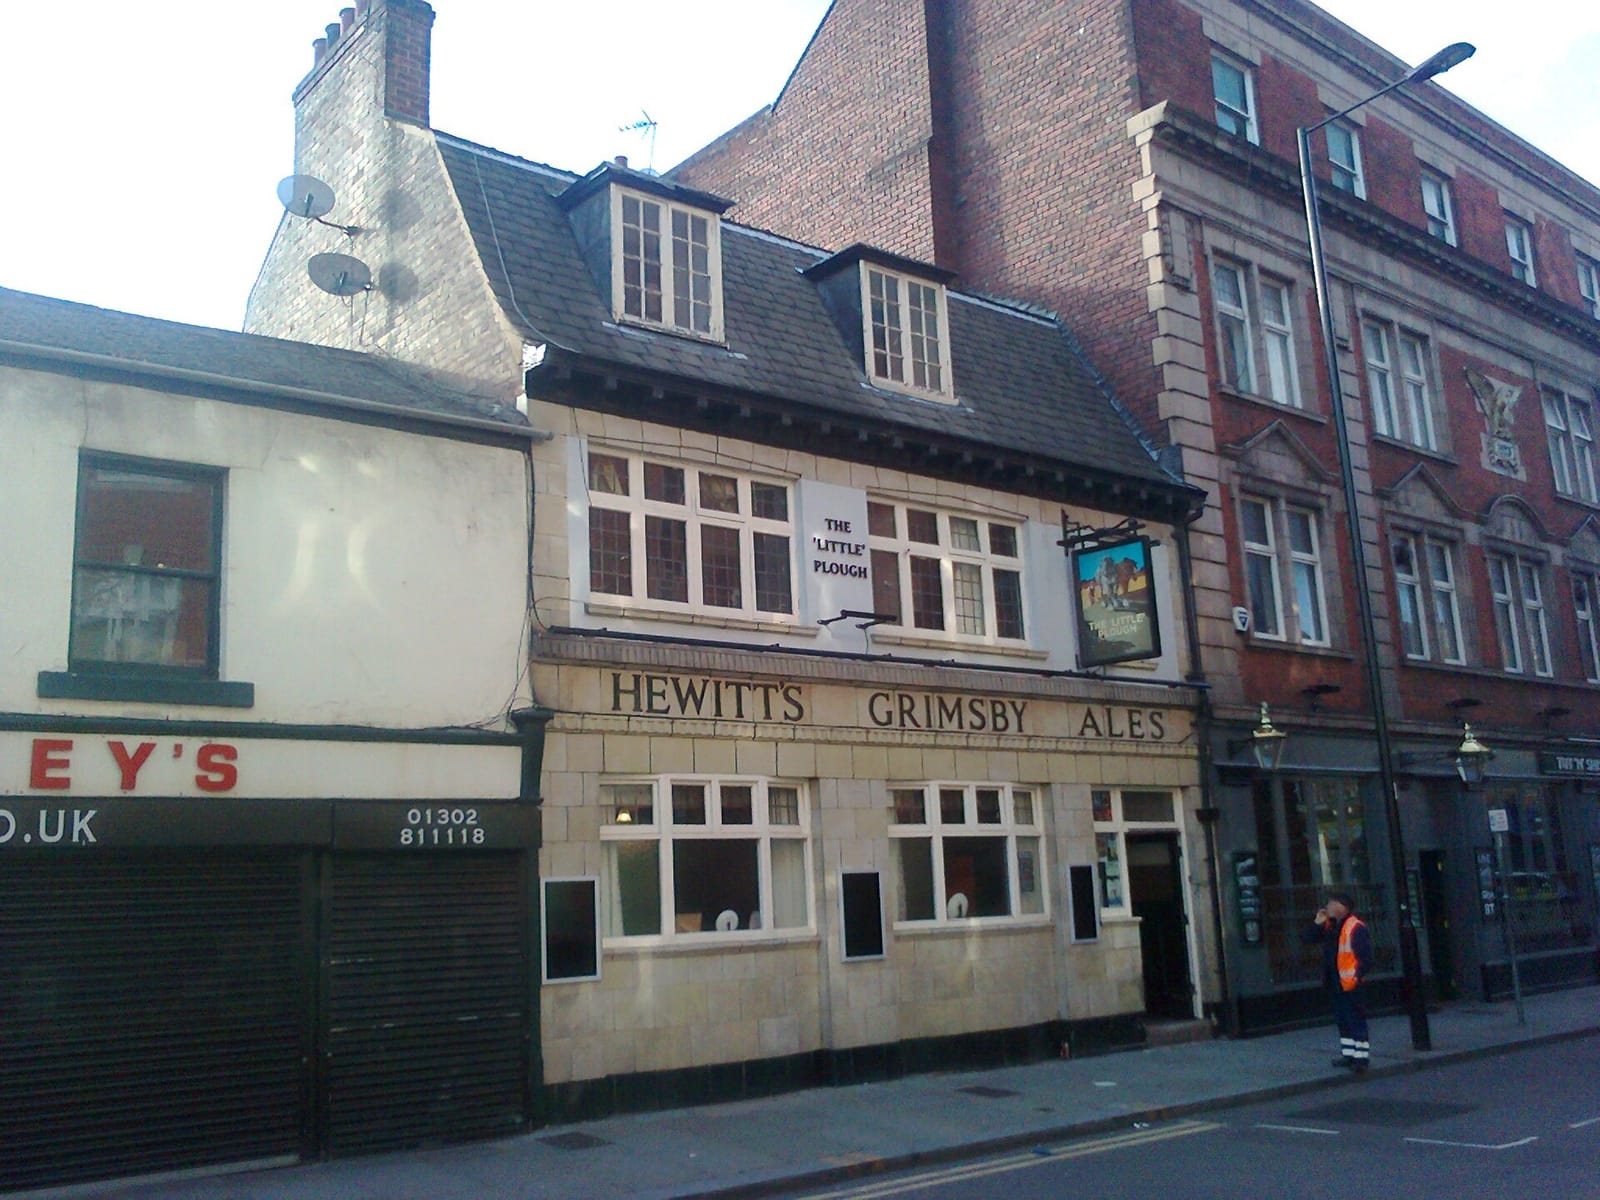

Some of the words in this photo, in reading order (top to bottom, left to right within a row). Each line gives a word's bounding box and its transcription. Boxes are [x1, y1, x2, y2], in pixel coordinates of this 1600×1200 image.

[824, 518, 851, 533] THE
[813, 537, 865, 556] 'LITTLE'
[814, 560, 867, 579] PLOUGH
[611, 672, 805, 722] HEWITT'S
[868, 692, 1028, 733] GRIMSBY
[1078, 707, 1165, 740] ALES
[407, 808, 478, 825] 01302
[400, 828, 485, 845] 811118
